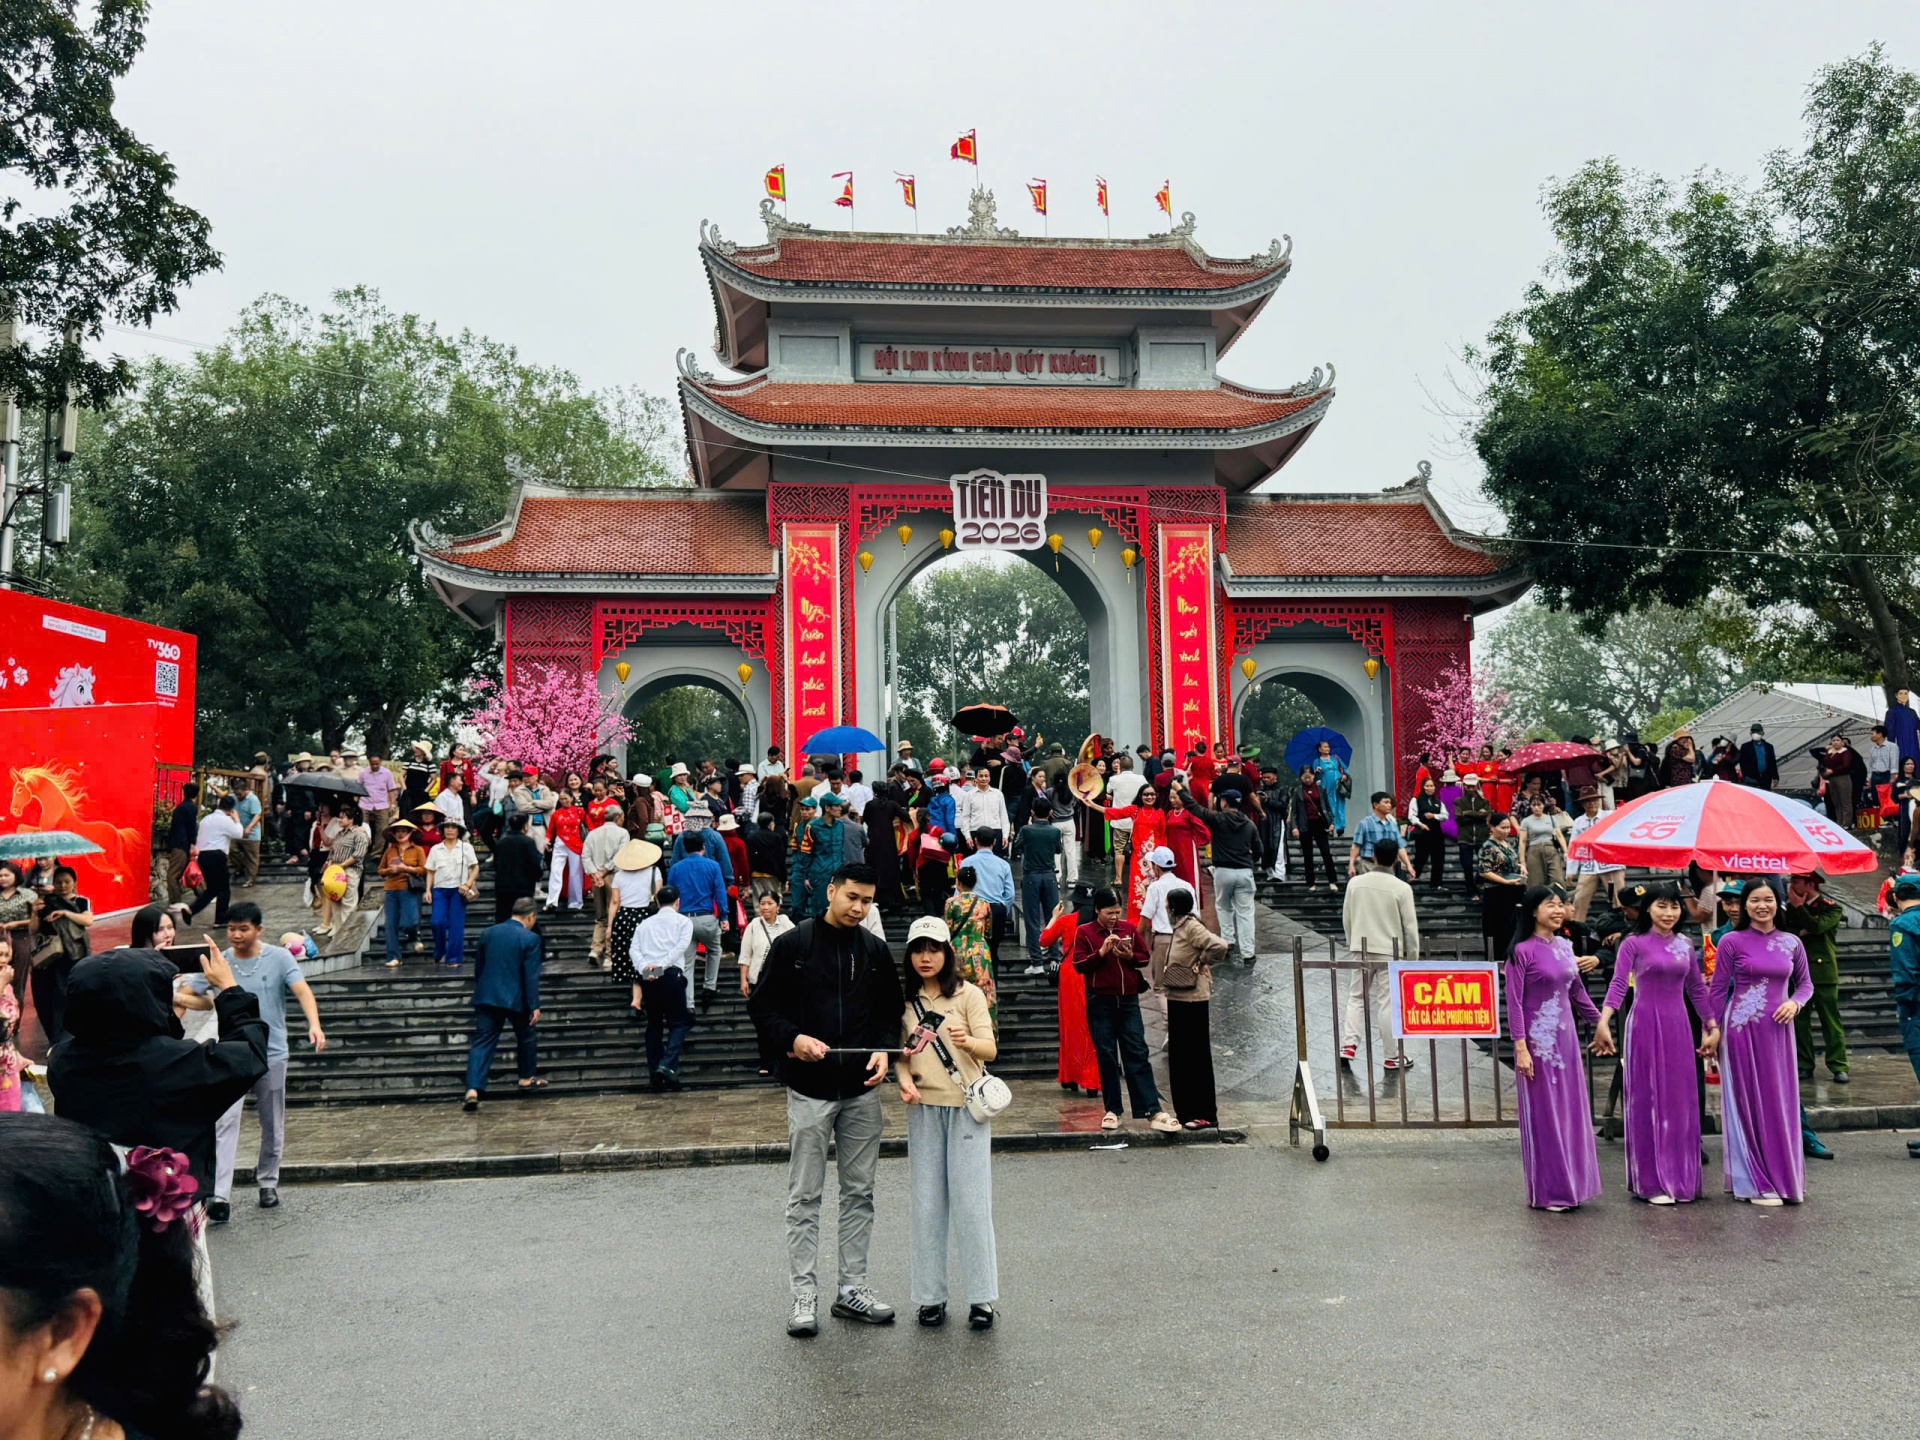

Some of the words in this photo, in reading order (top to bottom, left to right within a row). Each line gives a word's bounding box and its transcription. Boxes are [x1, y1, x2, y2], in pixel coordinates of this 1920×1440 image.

[903, 350, 928, 370] LIM
[933, 347, 969, 371] KÍNH
[973, 348, 1011, 372] CHÀO
[1049, 349, 1096, 373] KHÁCH
[962, 521, 1040, 544] 2026
[1629, 821, 1682, 841] 5G
[1805, 824, 1843, 846] 5G
[1720, 853, 1790, 870] viettel
[1414, 975, 1481, 1004] CẤM
[1408, 1005, 1419, 1024] TẤT
[1421, 1006, 1431, 1024] CẢ
